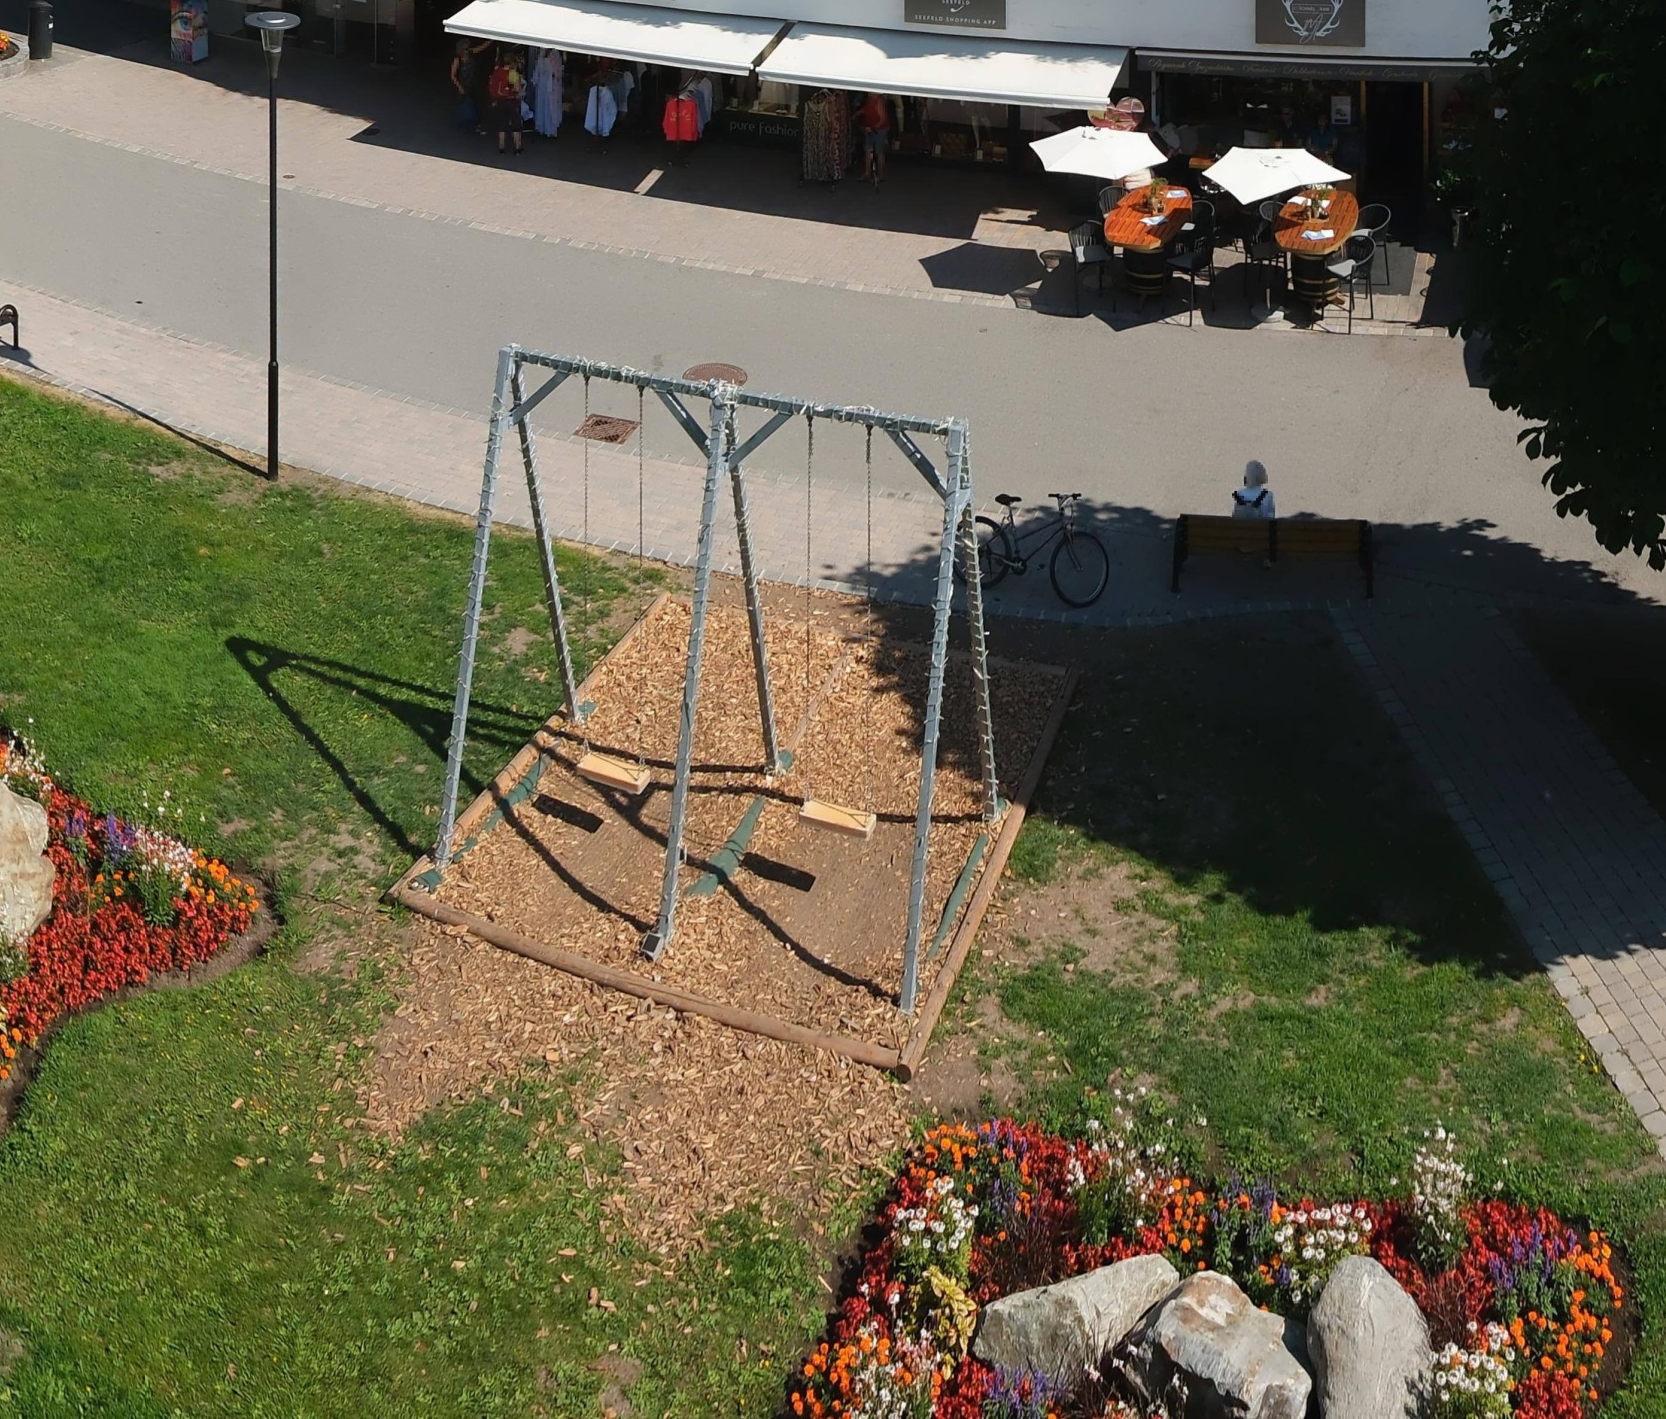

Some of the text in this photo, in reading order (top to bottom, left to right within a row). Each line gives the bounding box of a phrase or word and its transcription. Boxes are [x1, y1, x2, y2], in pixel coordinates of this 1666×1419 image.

[914, 14, 943, 22] SEEFELD
[945, 16, 981, 24] SHOPPING
[729, 121, 755, 131] pure
